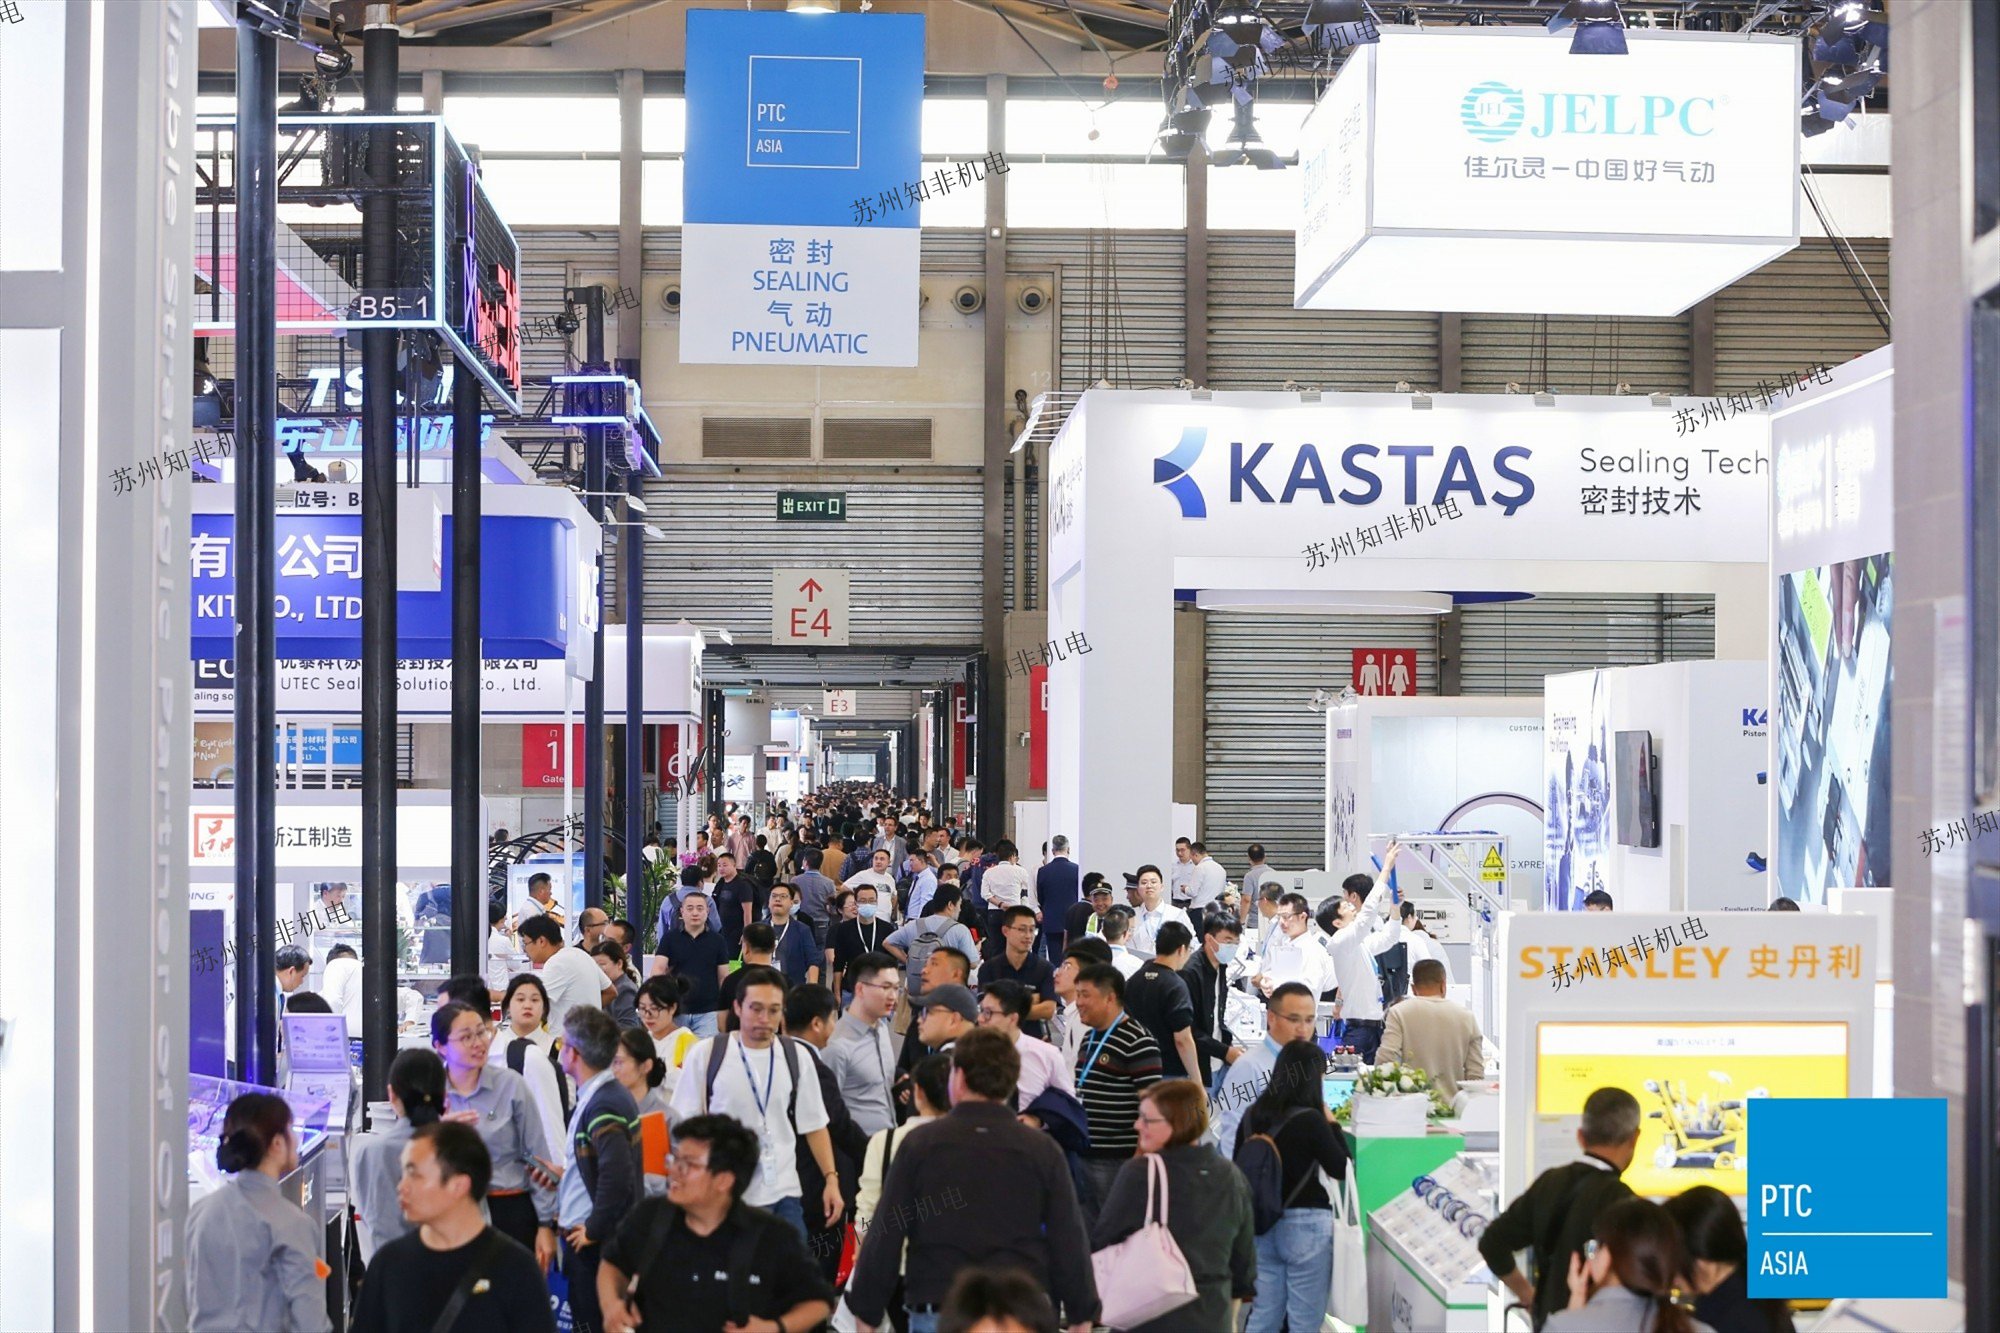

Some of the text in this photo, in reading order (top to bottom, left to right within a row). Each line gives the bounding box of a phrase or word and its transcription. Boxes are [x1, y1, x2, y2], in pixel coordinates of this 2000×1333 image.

[757, 103, 786, 123] PTC
[1530, 92, 1715, 138] JELPC
[756, 139, 783, 154] ASIA
[753, 270, 849, 293] SEALING
[360, 295, 428, 319] B5-1
[732, 331, 868, 355] PNEUMATIC
[1580, 447, 1769, 481] Sealing Tech
[1229, 442, 1535, 517] KASTAŞ
[796, 499, 826, 512] EXIT
[1580, 485, 1701, 516] 密封技术
[790, 607, 832, 638] E4
[281, 677, 320, 690] UTEC
[513, 677, 541, 691] Ltd.
[831, 699, 848, 713] E3
[547, 741, 558, 770] 1
[542, 775, 565, 784] Gate
[1519, 943, 1862, 980] STANLEY 史丹利
